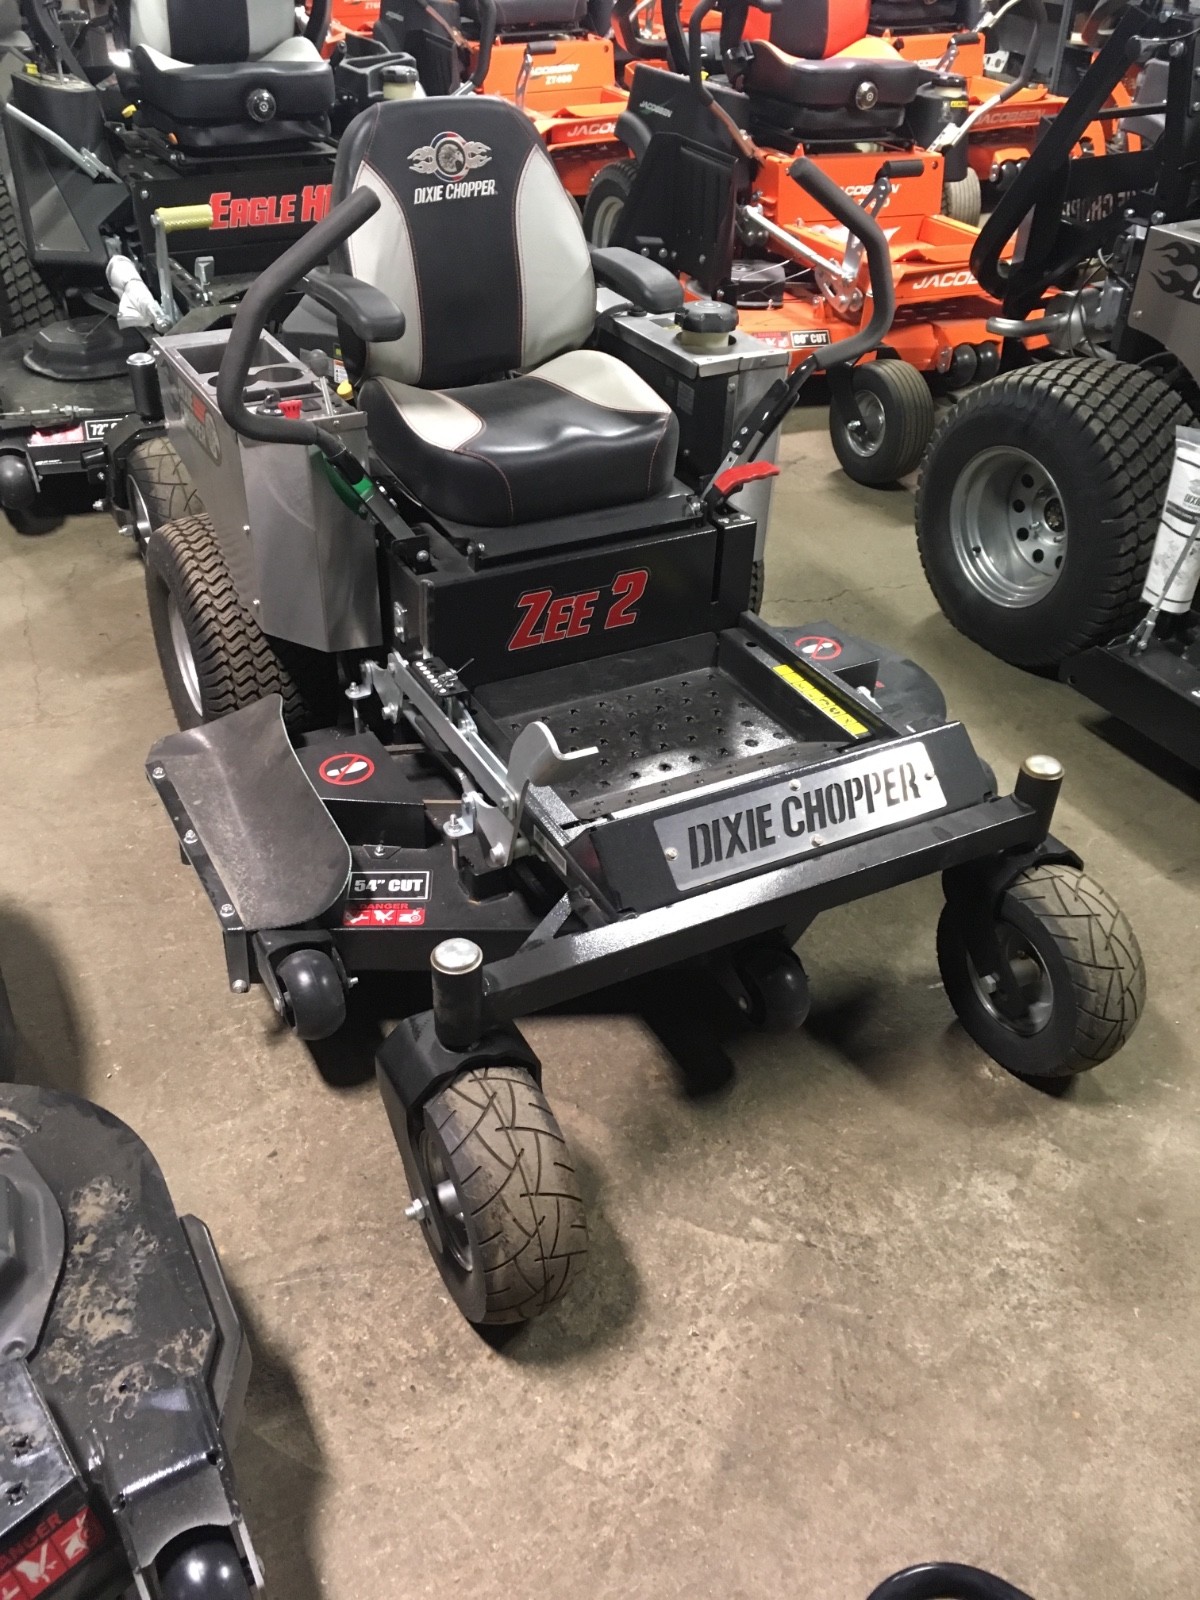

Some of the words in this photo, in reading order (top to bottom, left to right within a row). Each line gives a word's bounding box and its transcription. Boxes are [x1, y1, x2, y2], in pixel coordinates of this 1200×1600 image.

[413, 184, 444, 205] DIXIE
[444, 179, 496, 200] CHOPPER
[209, 191, 298, 230] EAGLE
[809, 333, 827, 344] CUT
[508, 589, 600, 651] ZEE
[603, 569, 649, 630] 2
[687, 803, 777, 870] DIXIE
[781, 761, 922, 838] CHOPPER
[354, 878, 386, 892] 54"
[387, 879, 424, 892] CUT
